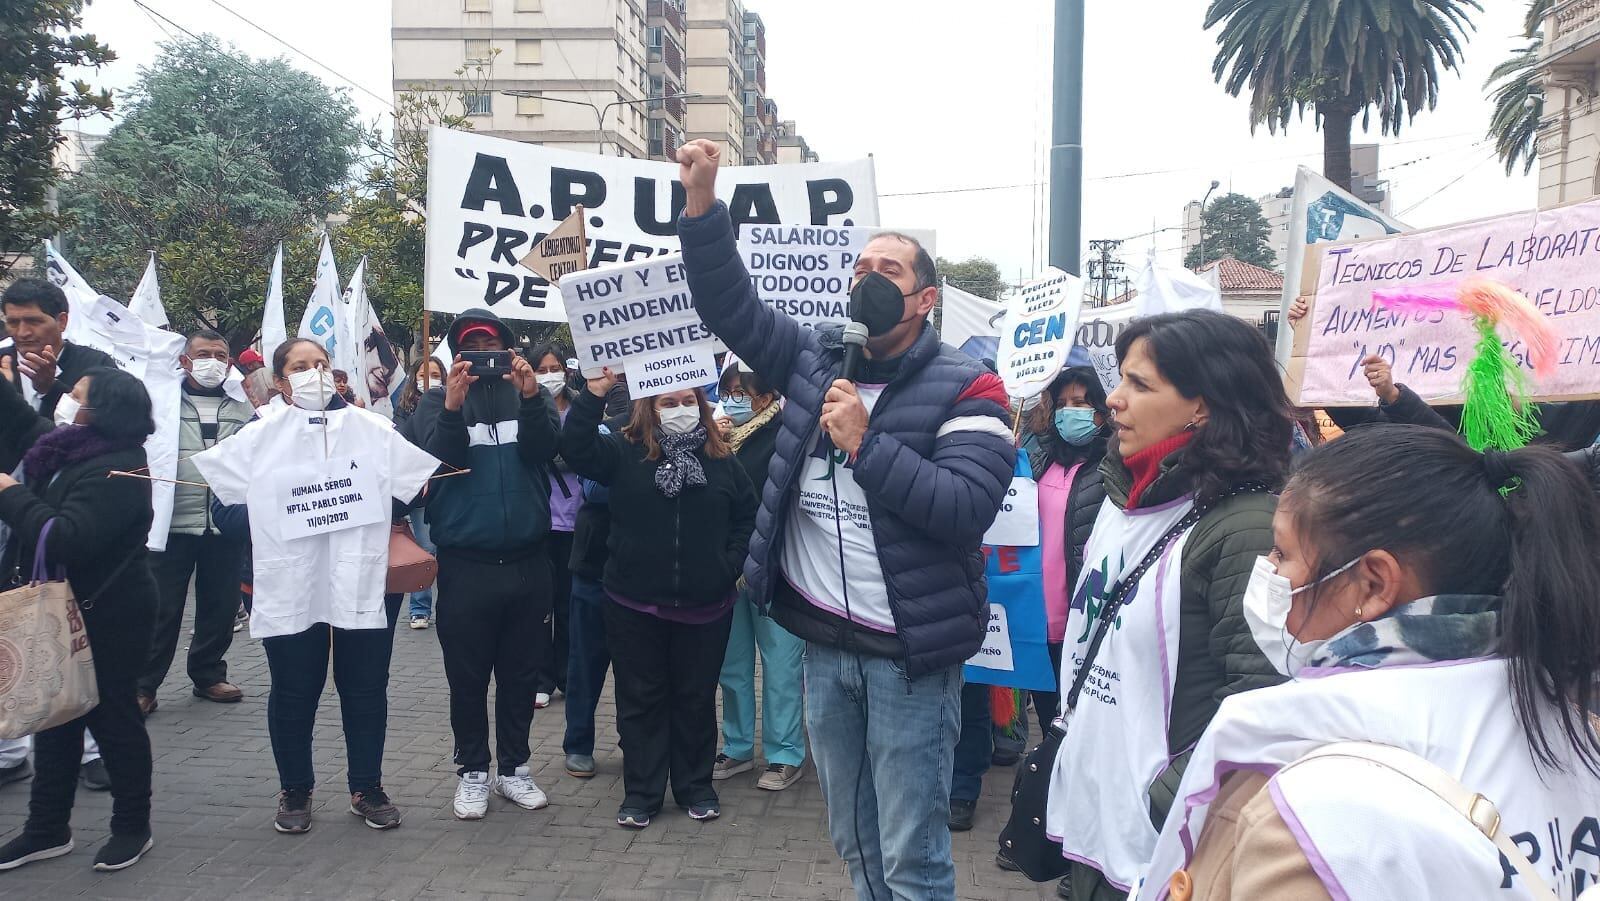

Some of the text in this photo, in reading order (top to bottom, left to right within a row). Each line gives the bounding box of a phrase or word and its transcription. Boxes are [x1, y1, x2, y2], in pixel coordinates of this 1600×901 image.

[540, 235, 580, 258] LABORATORIO
[750, 227, 850, 246] SALARIOS
[750, 252, 829, 271] DIGNOS
[1328, 227, 1600, 286] TÉCNICOS DE LABORAT
[576, 274, 623, 301] HOY
[635, 268, 649, 287] Y
[750, 274, 842, 294] TODOOO
[1013, 311, 1066, 349] CEN
[644, 354, 696, 373] HOSPITAL
[1408, 345, 1457, 374] MAS
[639, 368, 708, 391] PABLO SORIA
[292, 477, 352, 498] HUMANA SERGIO
[800, 490, 829, 501] CIACION
[286, 492, 363, 515] HPTAL PABLO SORIA
[307, 511, 349, 528] 11/09/2020
